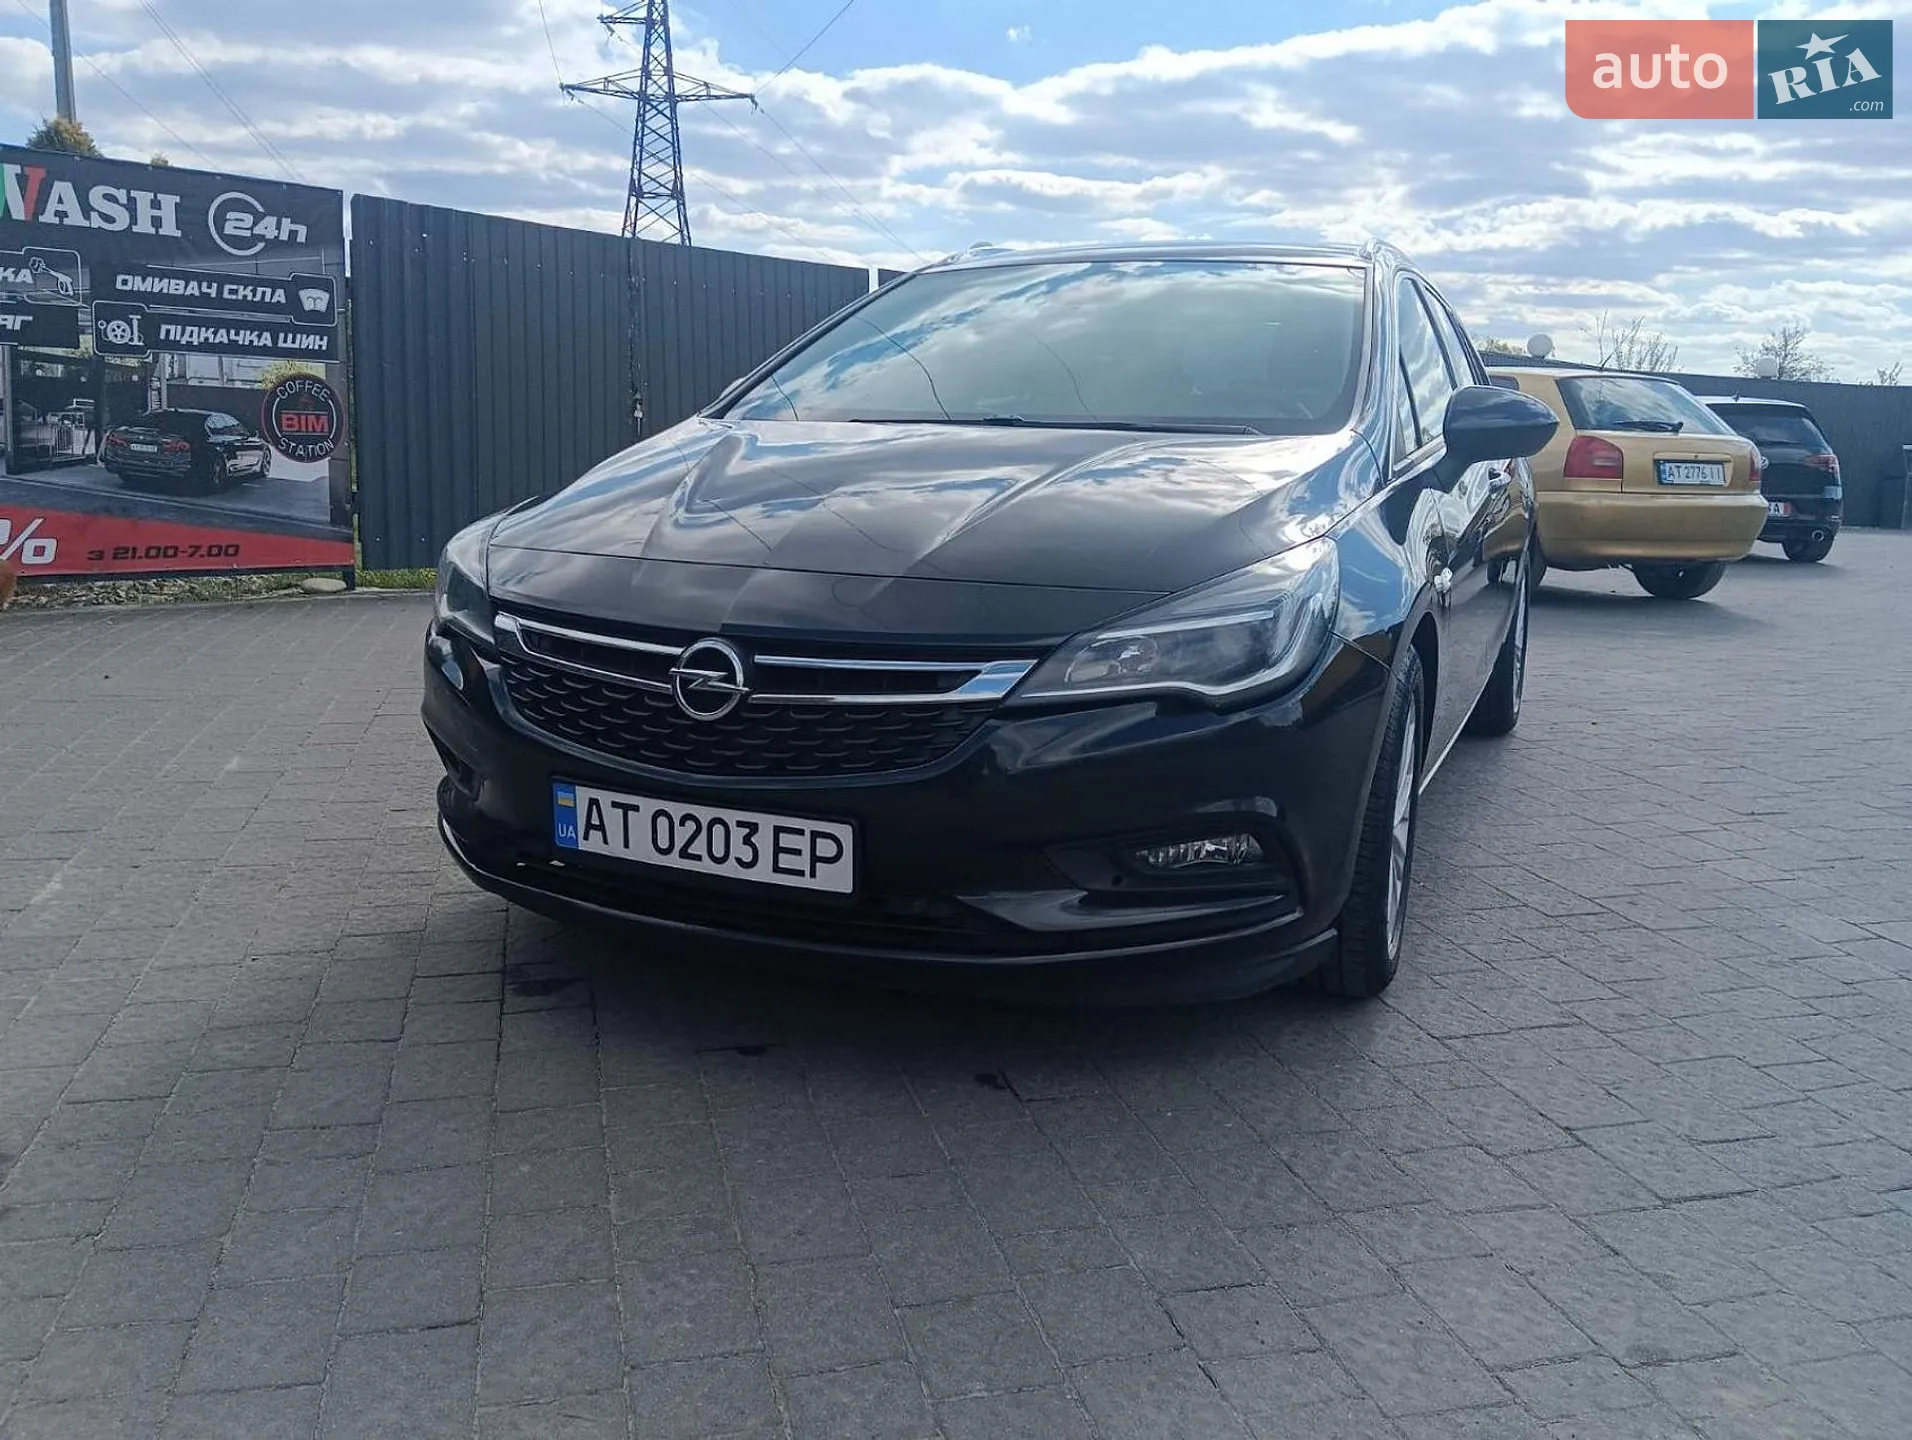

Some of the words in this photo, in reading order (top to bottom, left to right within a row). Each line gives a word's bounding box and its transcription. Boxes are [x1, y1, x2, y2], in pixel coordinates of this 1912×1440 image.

[223, 211, 308, 243] 24h
[115, 274, 217, 298] ОМИВАЧ
[223, 284, 287, 304] СКЛА
[159, 324, 272, 347] ПІДКАЧКА
[277, 333, 328, 351] ШИН
[276, 380, 331, 402] COFFEE
[281, 414, 329, 432] BIM
[278, 437, 335, 457] STATION
[558, 823, 576, 840] UA
[583, 797, 640, 849] AT
[651, 808, 759, 869] 0203
[772, 825, 845, 879] EP
